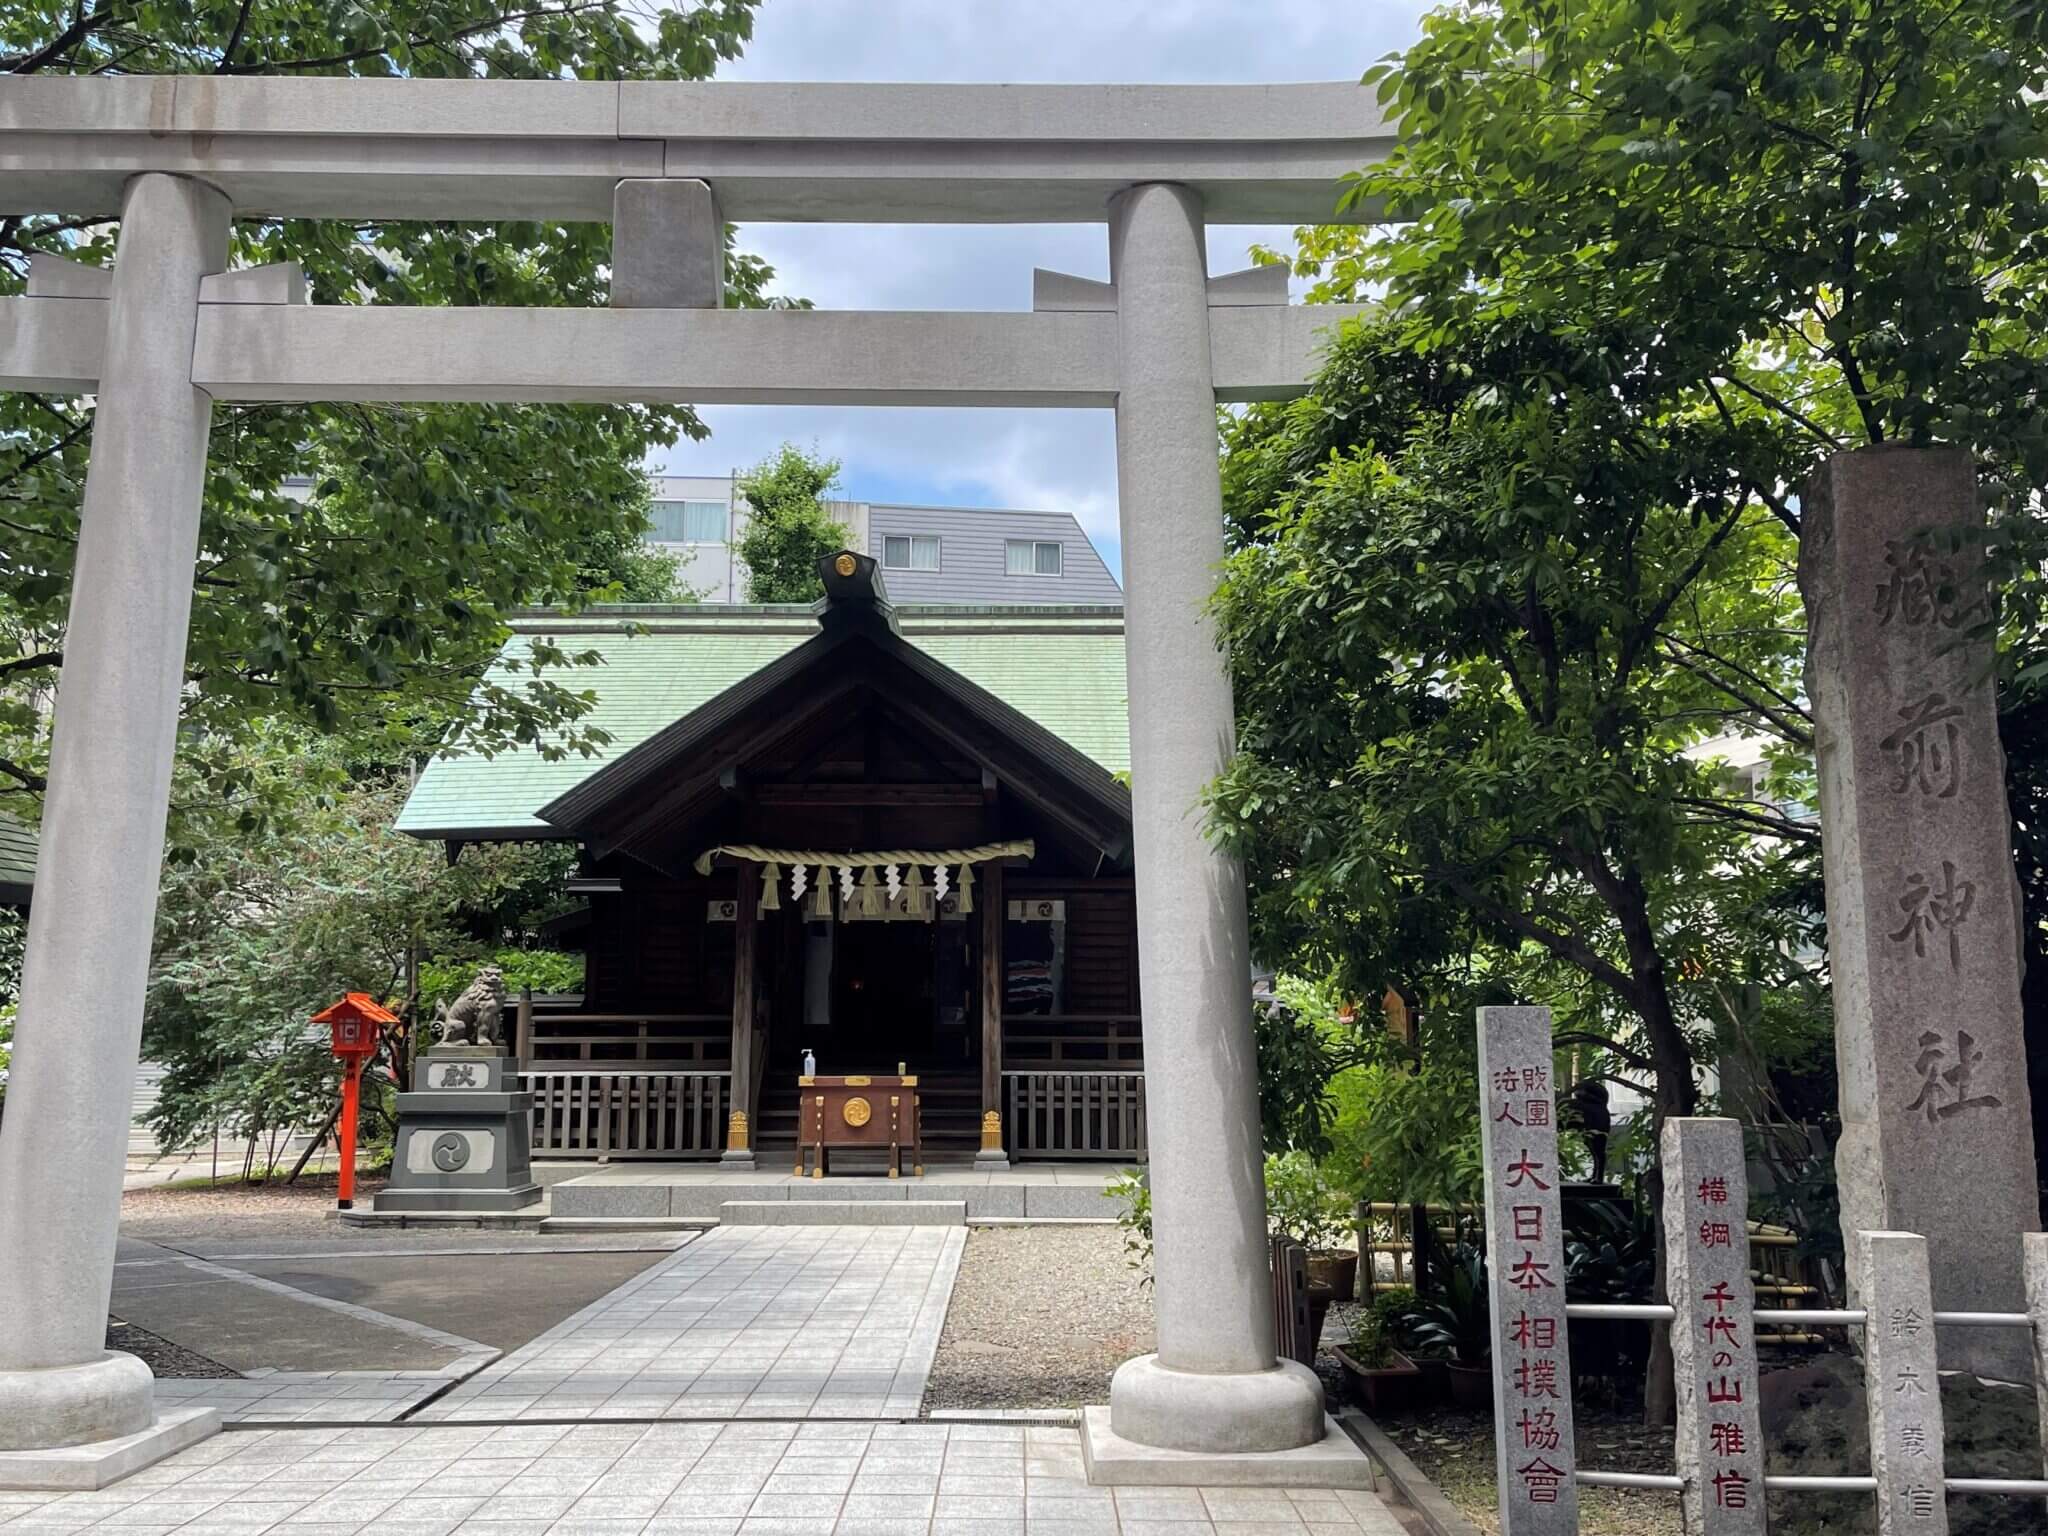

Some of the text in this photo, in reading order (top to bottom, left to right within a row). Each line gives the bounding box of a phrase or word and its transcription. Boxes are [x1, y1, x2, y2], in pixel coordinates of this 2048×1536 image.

[1493, 1066, 1523, 1126] 法人
[1505, 1148, 1568, 1504] 大日本相撲協會
[1889, 1307, 1936, 1518] 鈴木義信
